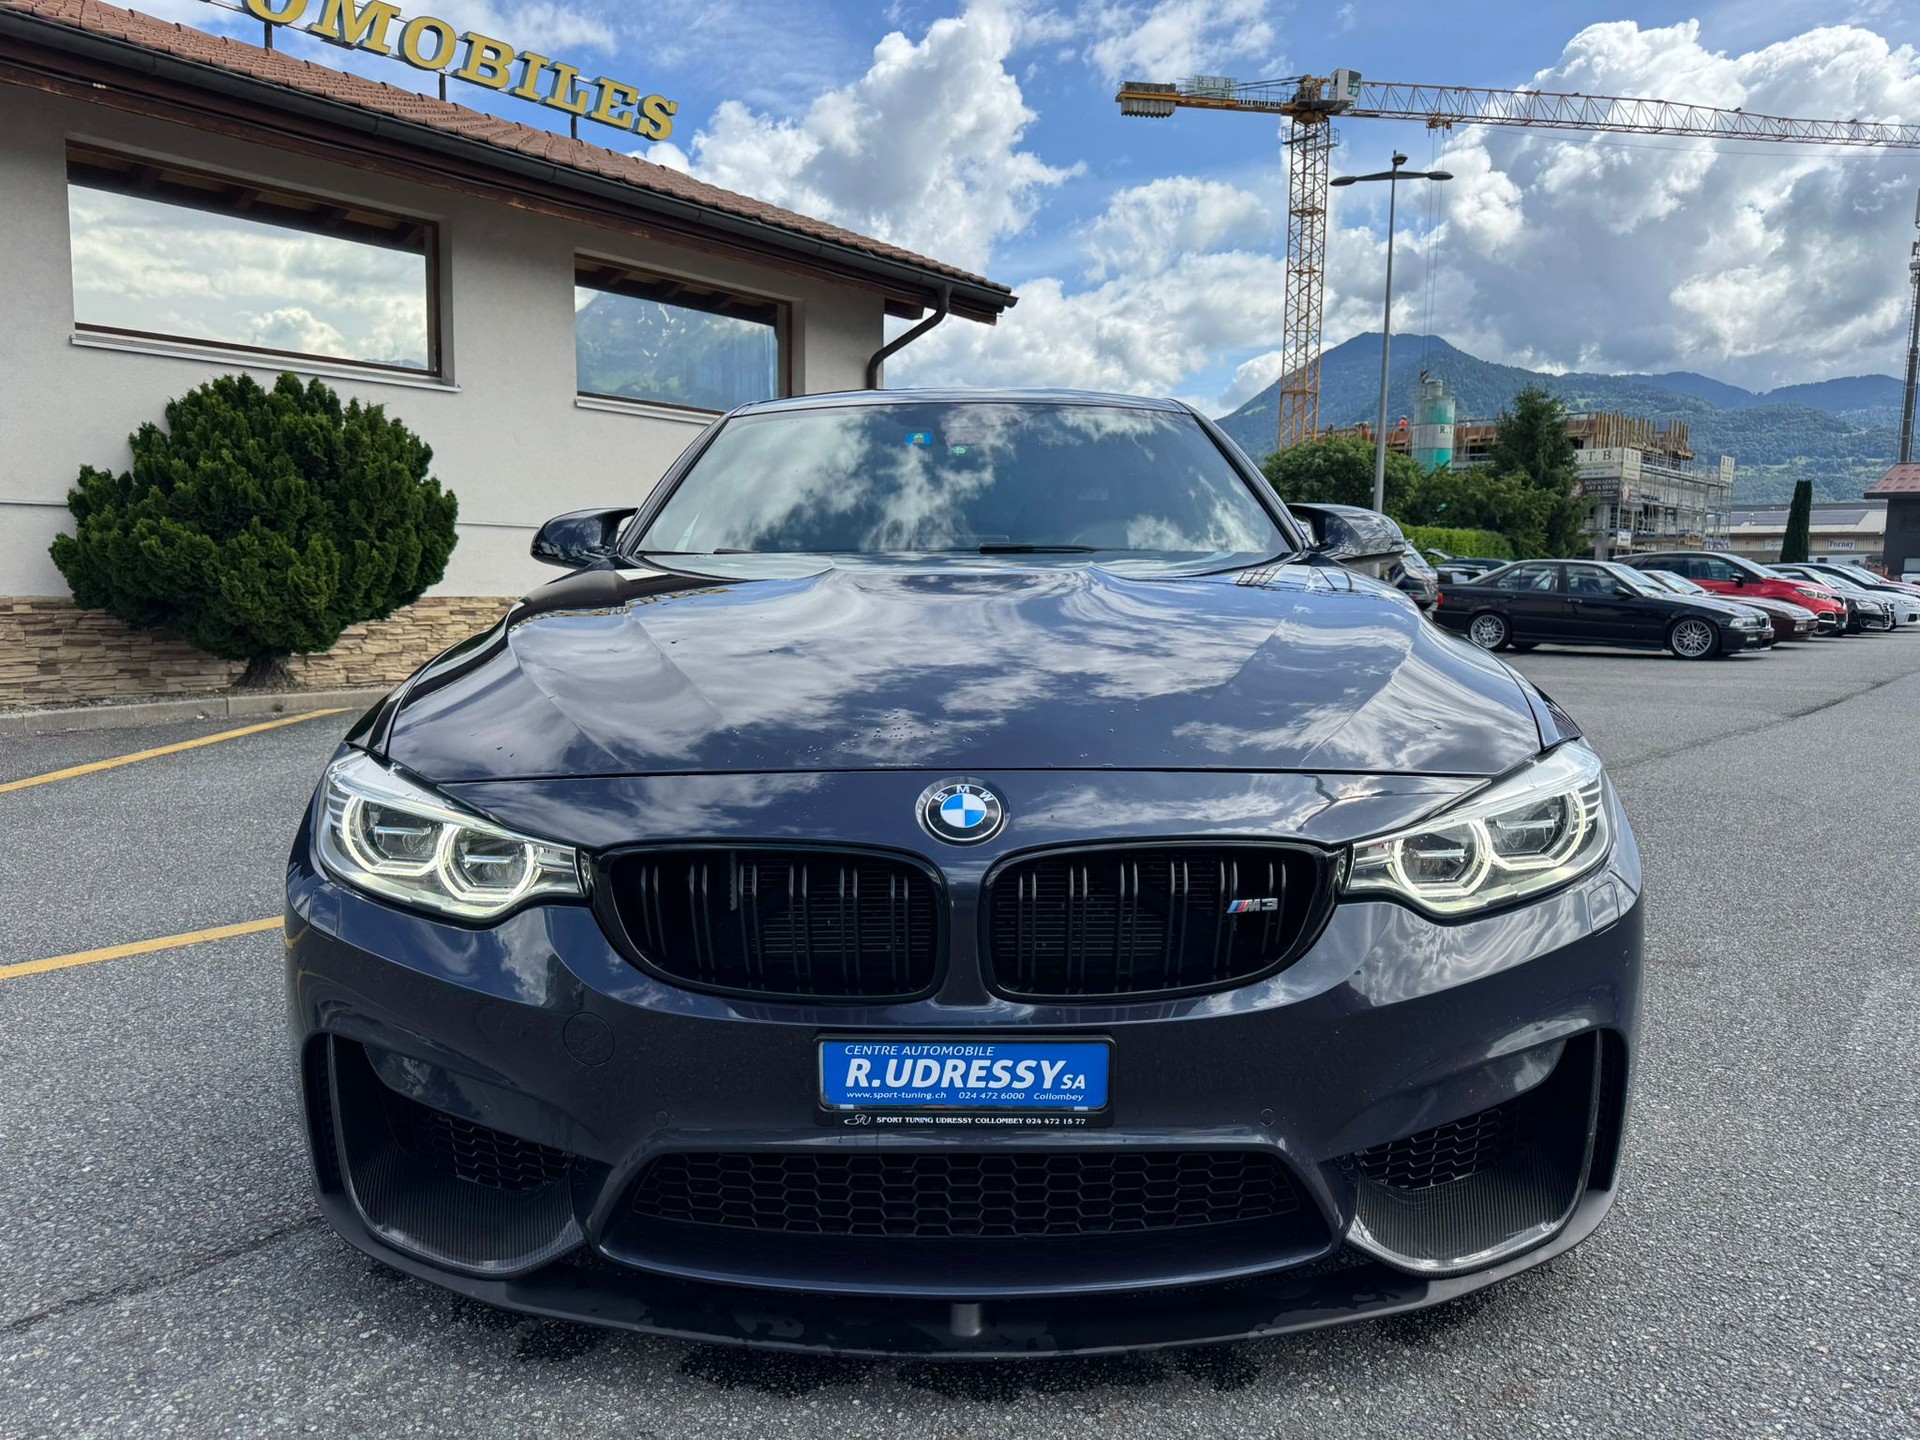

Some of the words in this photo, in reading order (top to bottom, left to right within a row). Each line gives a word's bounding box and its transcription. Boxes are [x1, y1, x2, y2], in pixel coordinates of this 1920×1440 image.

[1240, 99, 1282, 108] LIEBHERR
[1829, 540, 1854, 548] Fornay
[933, 784, 996, 802] BMW
[1240, 897, 1278, 912] M3
[845, 1045, 899, 1056] CENTRE
[901, 1046, 995, 1056] AUTOMOBILE
[1060, 1074, 1086, 1089] SA
[846, 1091, 947, 1100] www.sport-tuning.ch
[1001, 1092, 1025, 1100] 6000
[1033, 1093, 1084, 1101] Collombey
[876, 1116, 903, 1124] SPORT
[1026, 1117, 1042, 1125] 024
